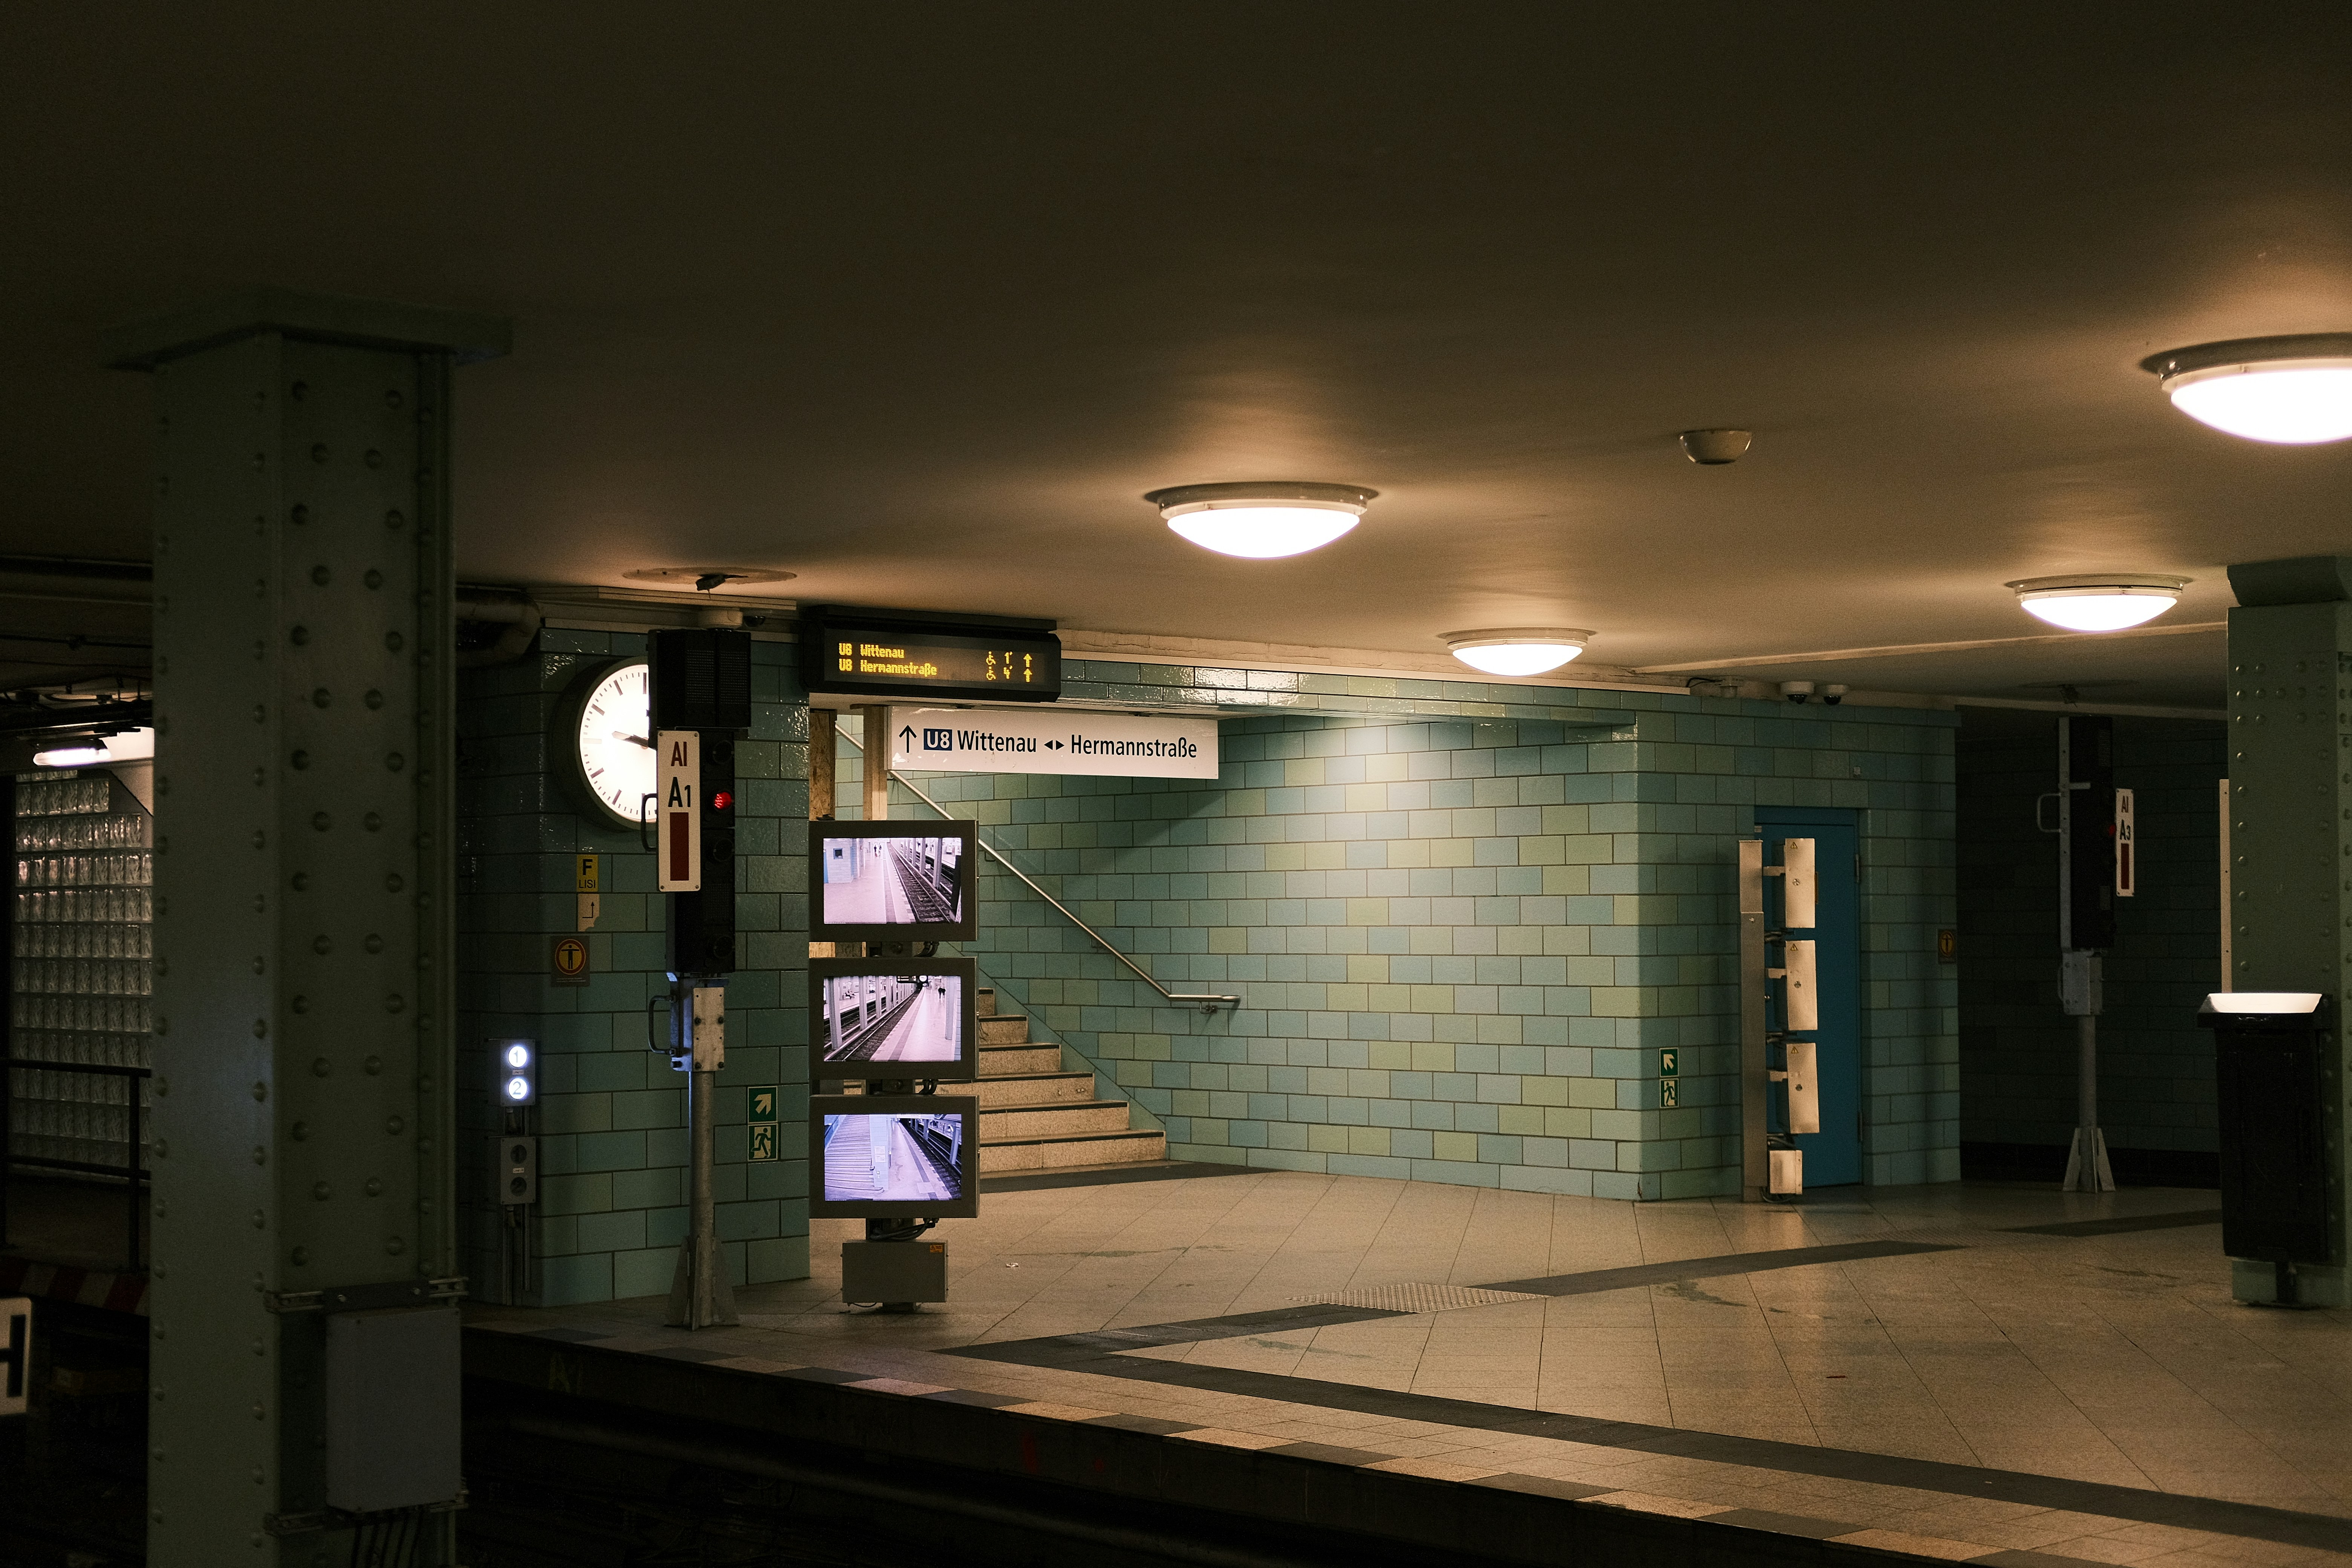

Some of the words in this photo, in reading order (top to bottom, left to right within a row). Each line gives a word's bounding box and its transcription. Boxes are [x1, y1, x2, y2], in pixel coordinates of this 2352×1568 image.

[839, 643, 852, 656] U8
[860, 644, 904, 658] Wittenau
[839, 658, 853, 671] U8
[860, 660, 937, 677] Hermannstraße
[927, 730, 950, 749] U8
[957, 730, 1037, 752] Wittenau
[1071, 734, 1197, 758] Hermannstraße
[668, 776, 691, 807] A1
[2119, 819, 2130, 840] A3
[582, 859, 593, 876] F
[579, 879, 596, 888] LISI
[513, 1050, 518, 1063] 1
[512, 1081, 521, 1095] 2
